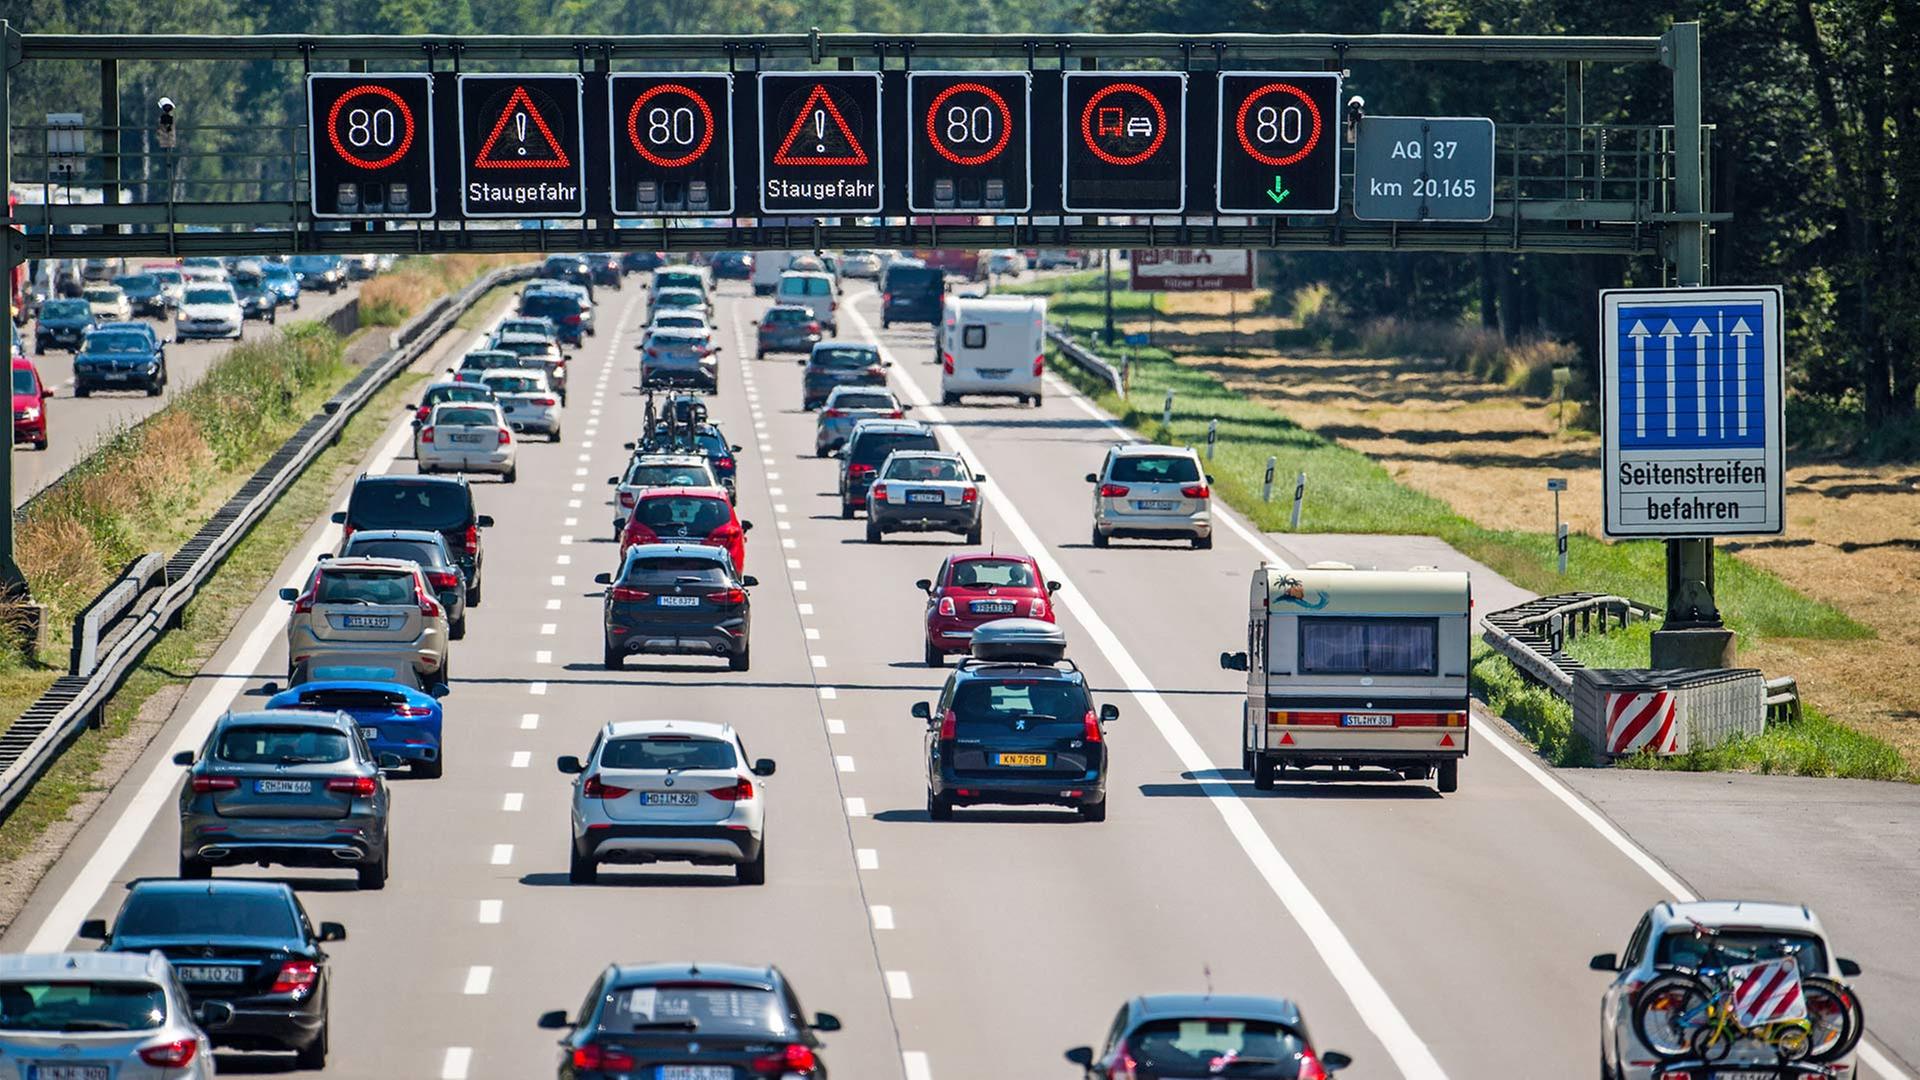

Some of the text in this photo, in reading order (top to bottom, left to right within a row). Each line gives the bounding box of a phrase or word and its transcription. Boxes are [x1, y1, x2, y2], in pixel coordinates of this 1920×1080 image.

[348, 108, 395, 146] 80
[648, 107, 694, 145] 80
[946, 105, 992, 143] 80
[1256, 106, 1302, 144] 80
[1391, 141, 1457, 159] AQ 37
[469, 182, 577, 204] Staugefahr
[767, 179, 875, 202] Staugefahr
[1370, 178, 1475, 198] km 20,165
[1620, 460, 1766, 485] Seitenstreifen
[1647, 496, 1740, 520] befahren
[1347, 716, 1363, 725] STL
[1004, 755, 1041, 764] KN 7696
[646, 793, 659, 804] HD
[678, 793, 696, 804] 328
